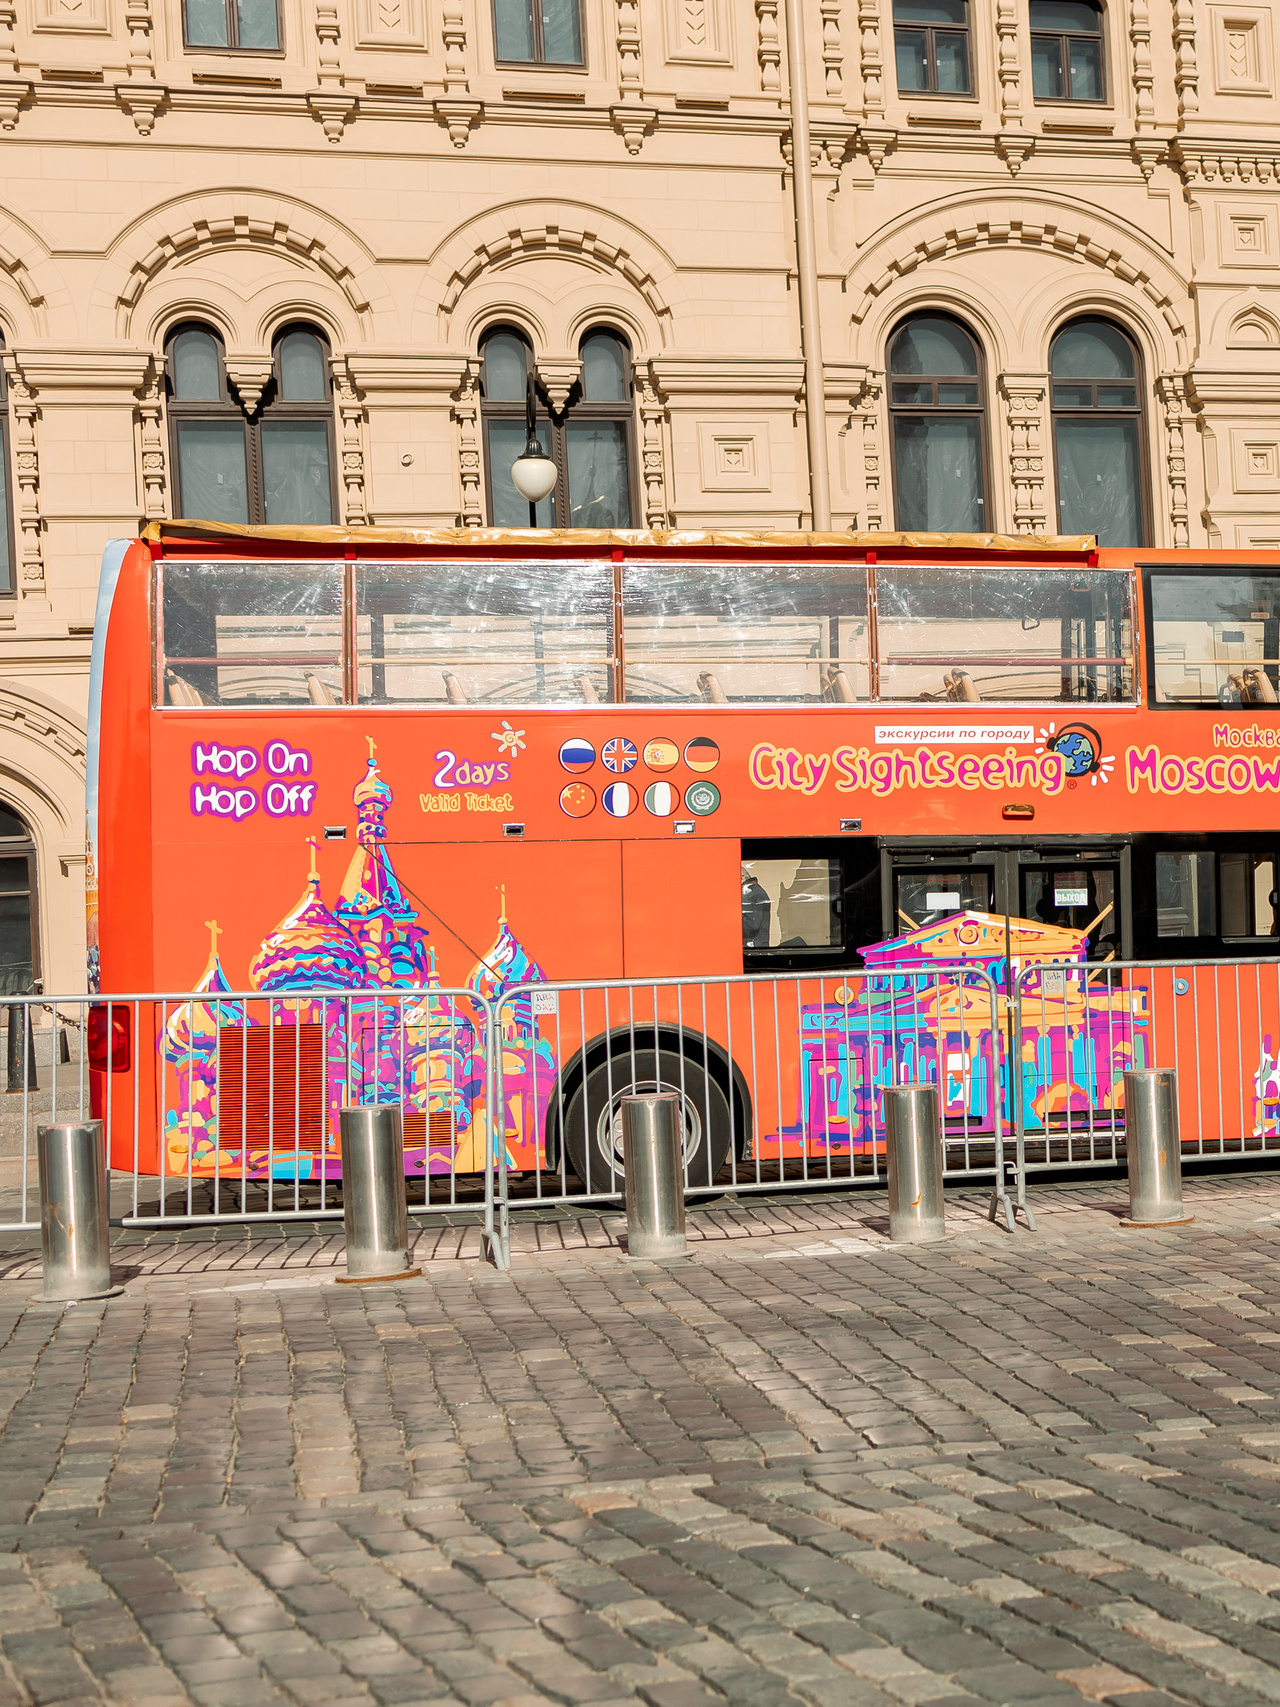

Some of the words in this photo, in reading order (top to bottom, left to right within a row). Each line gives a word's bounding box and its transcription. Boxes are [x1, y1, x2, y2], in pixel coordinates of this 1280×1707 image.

[878, 730, 955, 741] экскурсии
[958, 730, 977, 739] по
[980, 730, 1031, 741] городу
[193, 743, 259, 780] Hop
[265, 740, 310, 776] On
[749, 743, 829, 795] City
[833, 746, 1066, 797] Sightseeing
[192, 784, 257, 820] Hop
[264, 781, 317, 816] Off
[419, 793, 461, 813] Valid
[463, 792, 514, 812] Ticket
